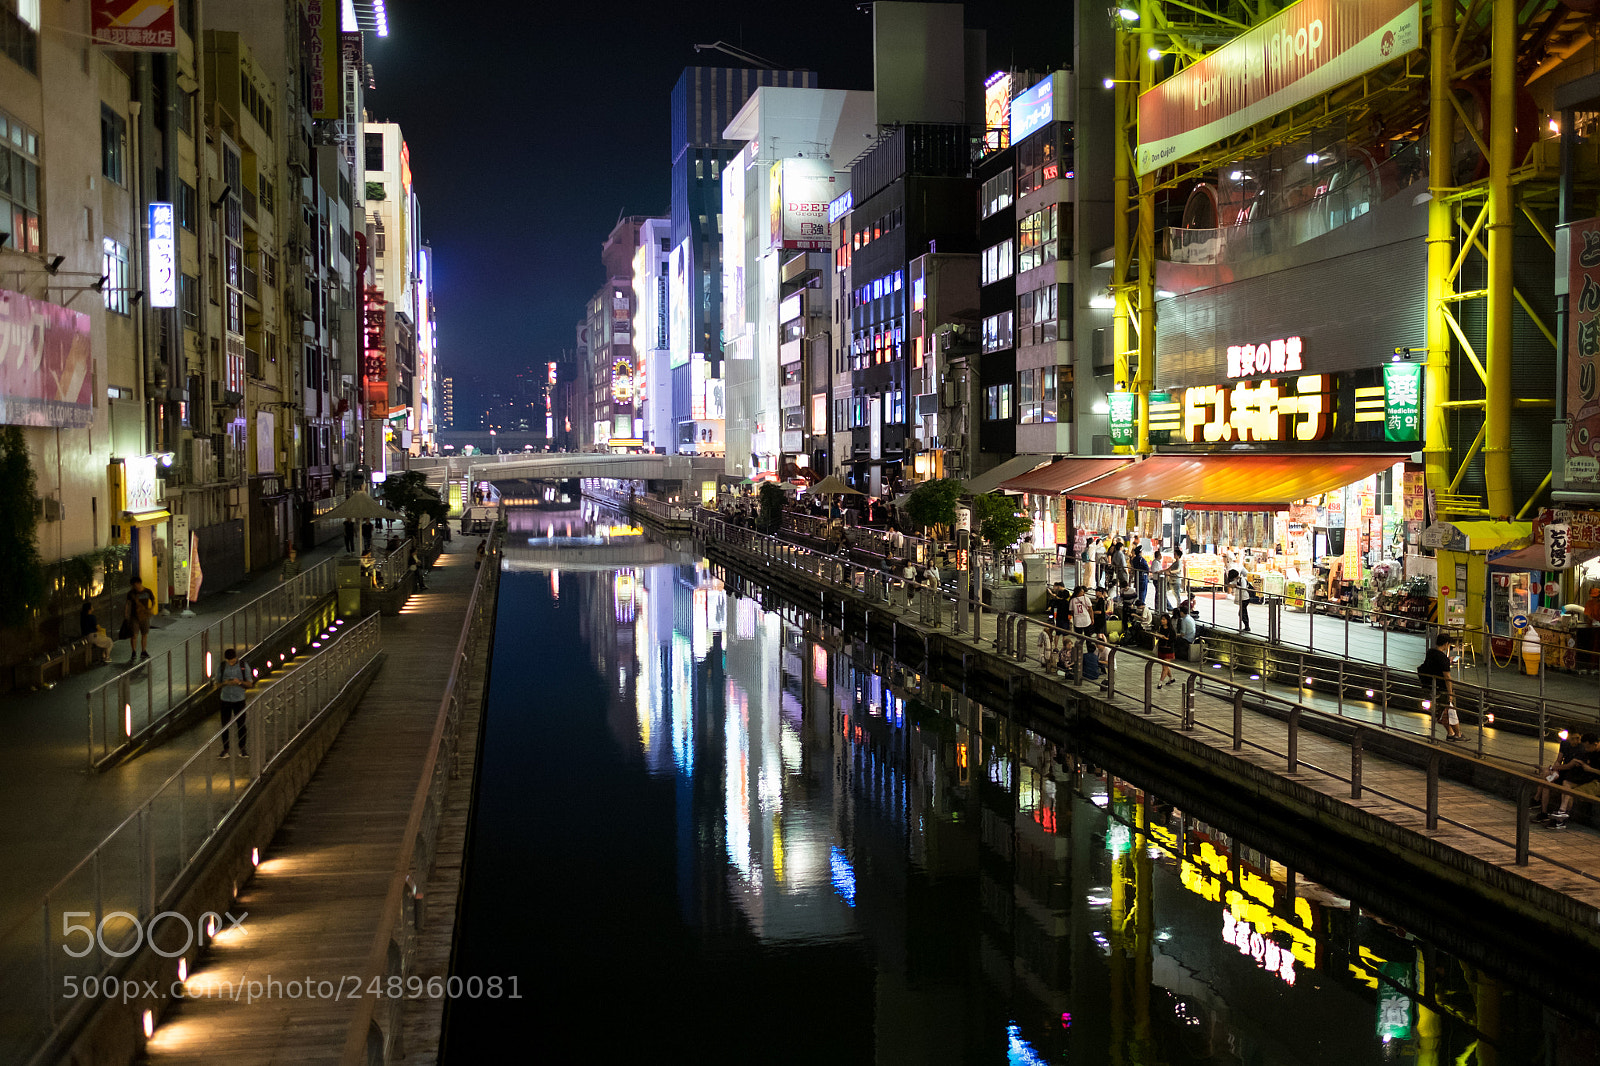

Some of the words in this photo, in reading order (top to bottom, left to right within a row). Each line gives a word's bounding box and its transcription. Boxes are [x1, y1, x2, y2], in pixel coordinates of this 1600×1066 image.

[1151, 153, 1160, 163] Don
[788, 202, 829, 213] DEEP
[1387, 374, 1418, 406] 薬
[1404, 415, 1418, 430] 약
